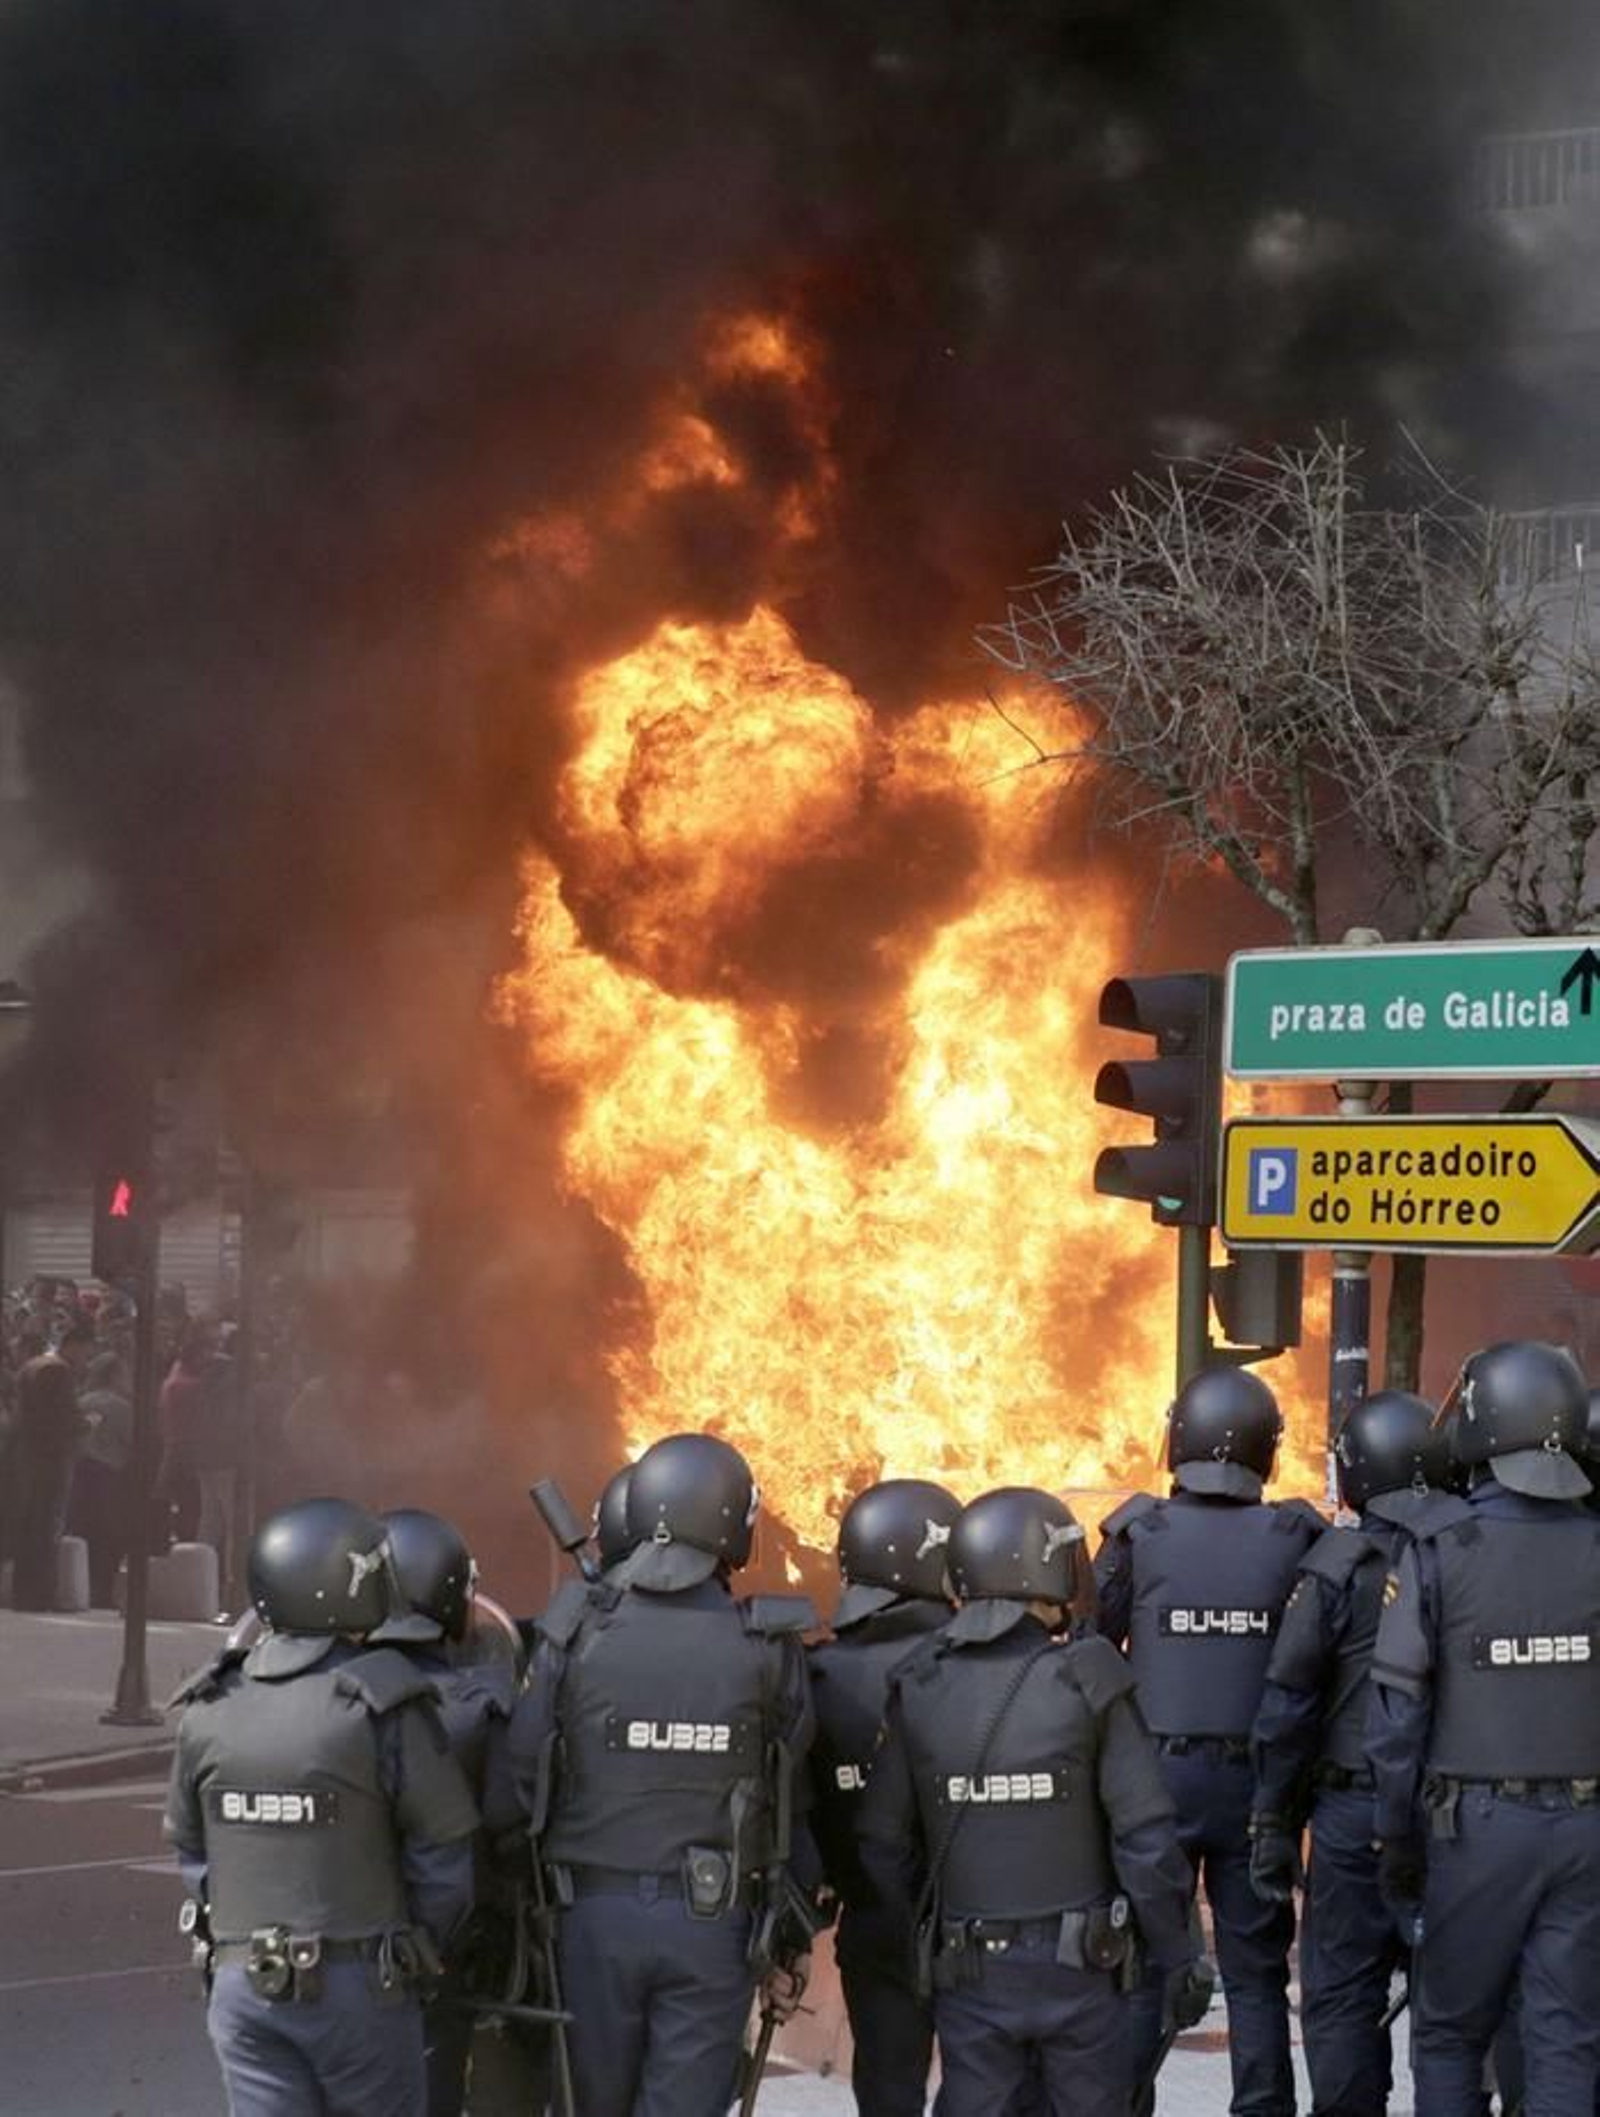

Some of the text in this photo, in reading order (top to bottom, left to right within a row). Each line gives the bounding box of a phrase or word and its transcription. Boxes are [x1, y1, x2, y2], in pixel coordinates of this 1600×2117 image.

[1270, 991, 1571, 1040] praza de Galicia
[1257, 1157, 1287, 1207] P
[1311, 1142, 1538, 1183] aparcadoiro
[1308, 1189, 1502, 1226] do Hórreo
[1170, 1609, 1268, 1634] 8U454
